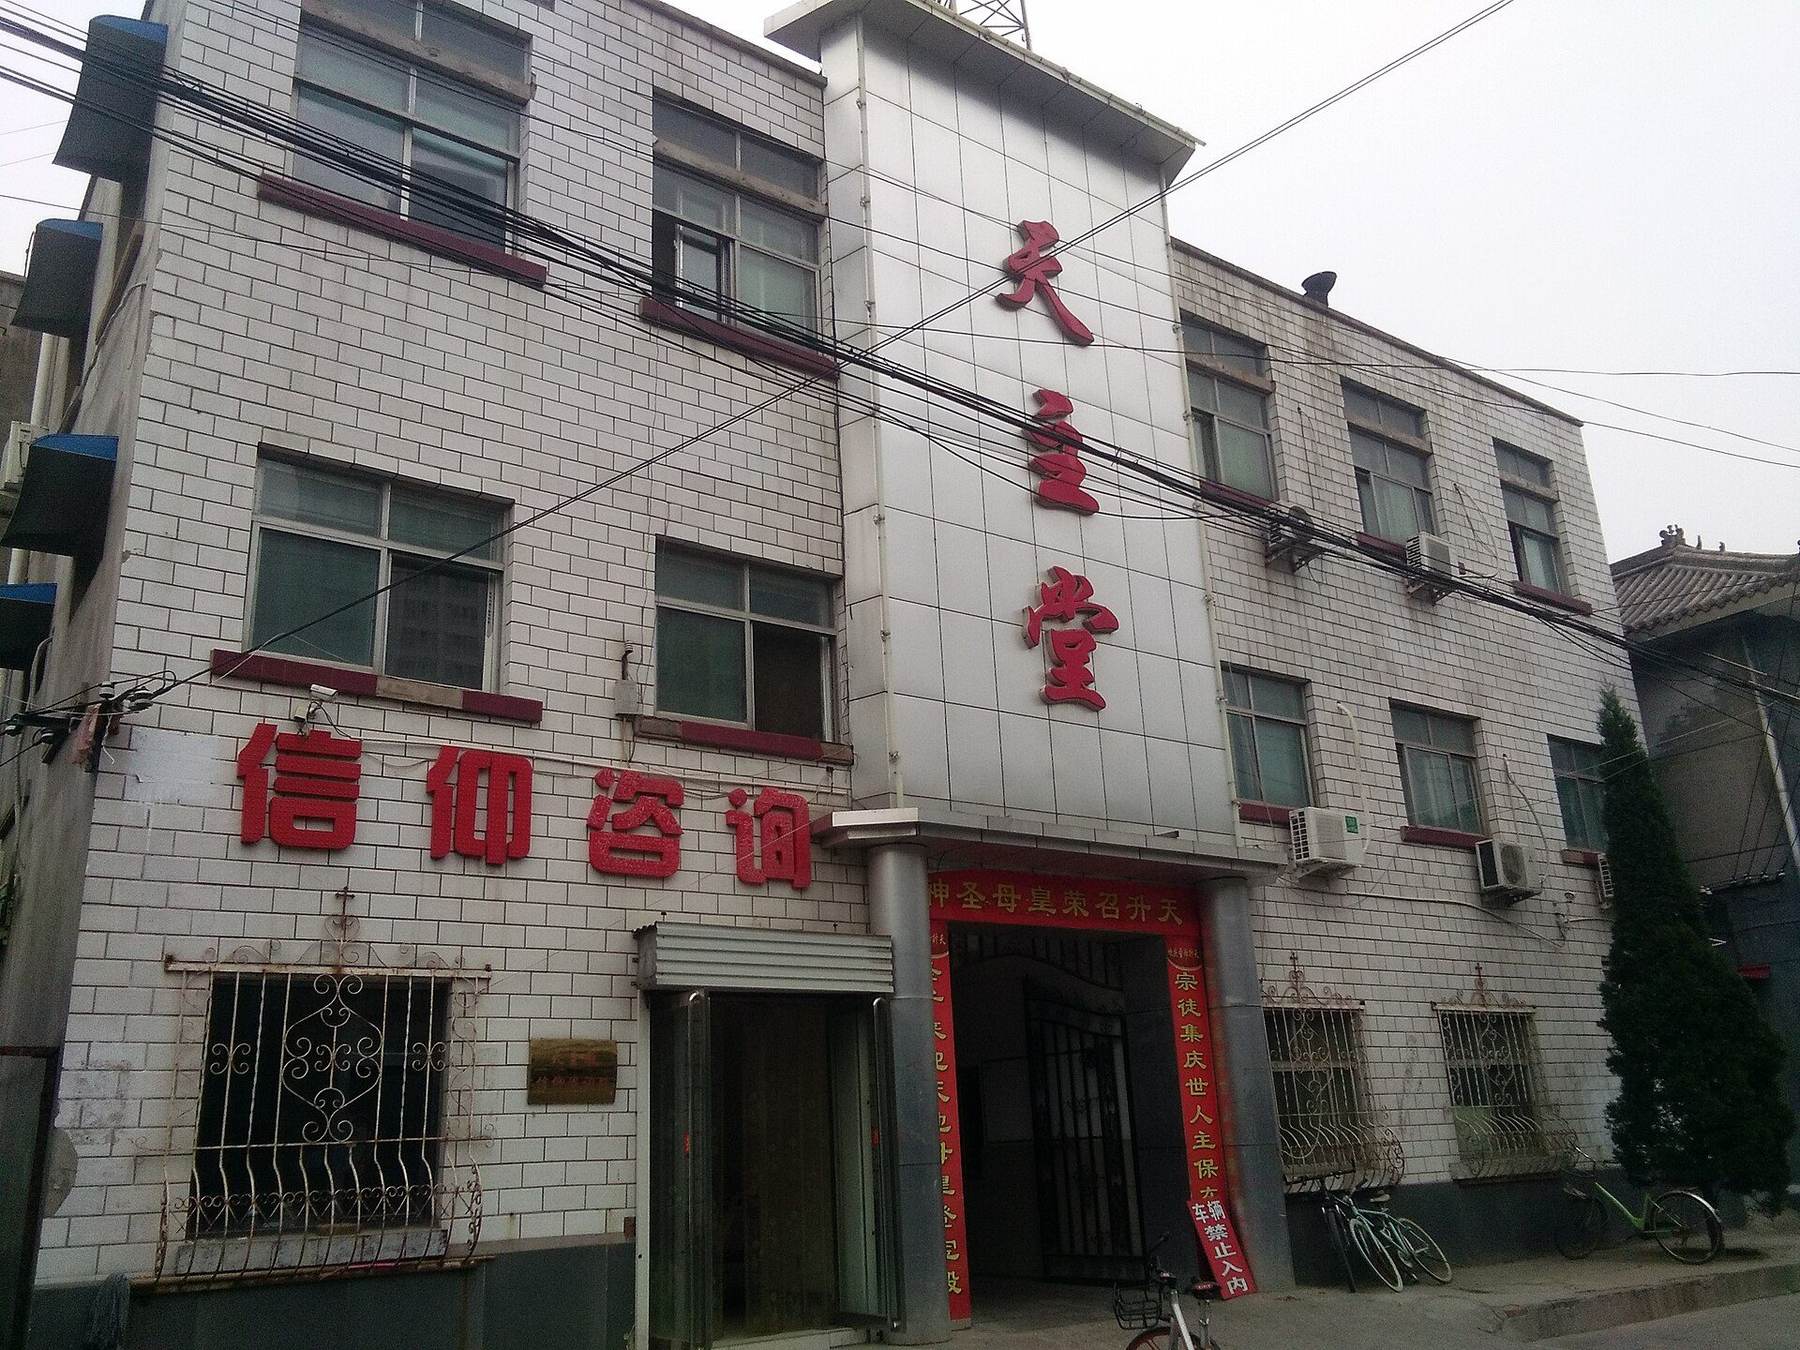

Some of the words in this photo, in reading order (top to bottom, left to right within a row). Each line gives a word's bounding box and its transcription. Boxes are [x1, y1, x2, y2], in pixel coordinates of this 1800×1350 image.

[994, 219, 1120, 713] 天主堂
[236, 722, 813, 890] 信仰咨询
[1191, 1199, 1249, 1295] 车辆禁止入内
